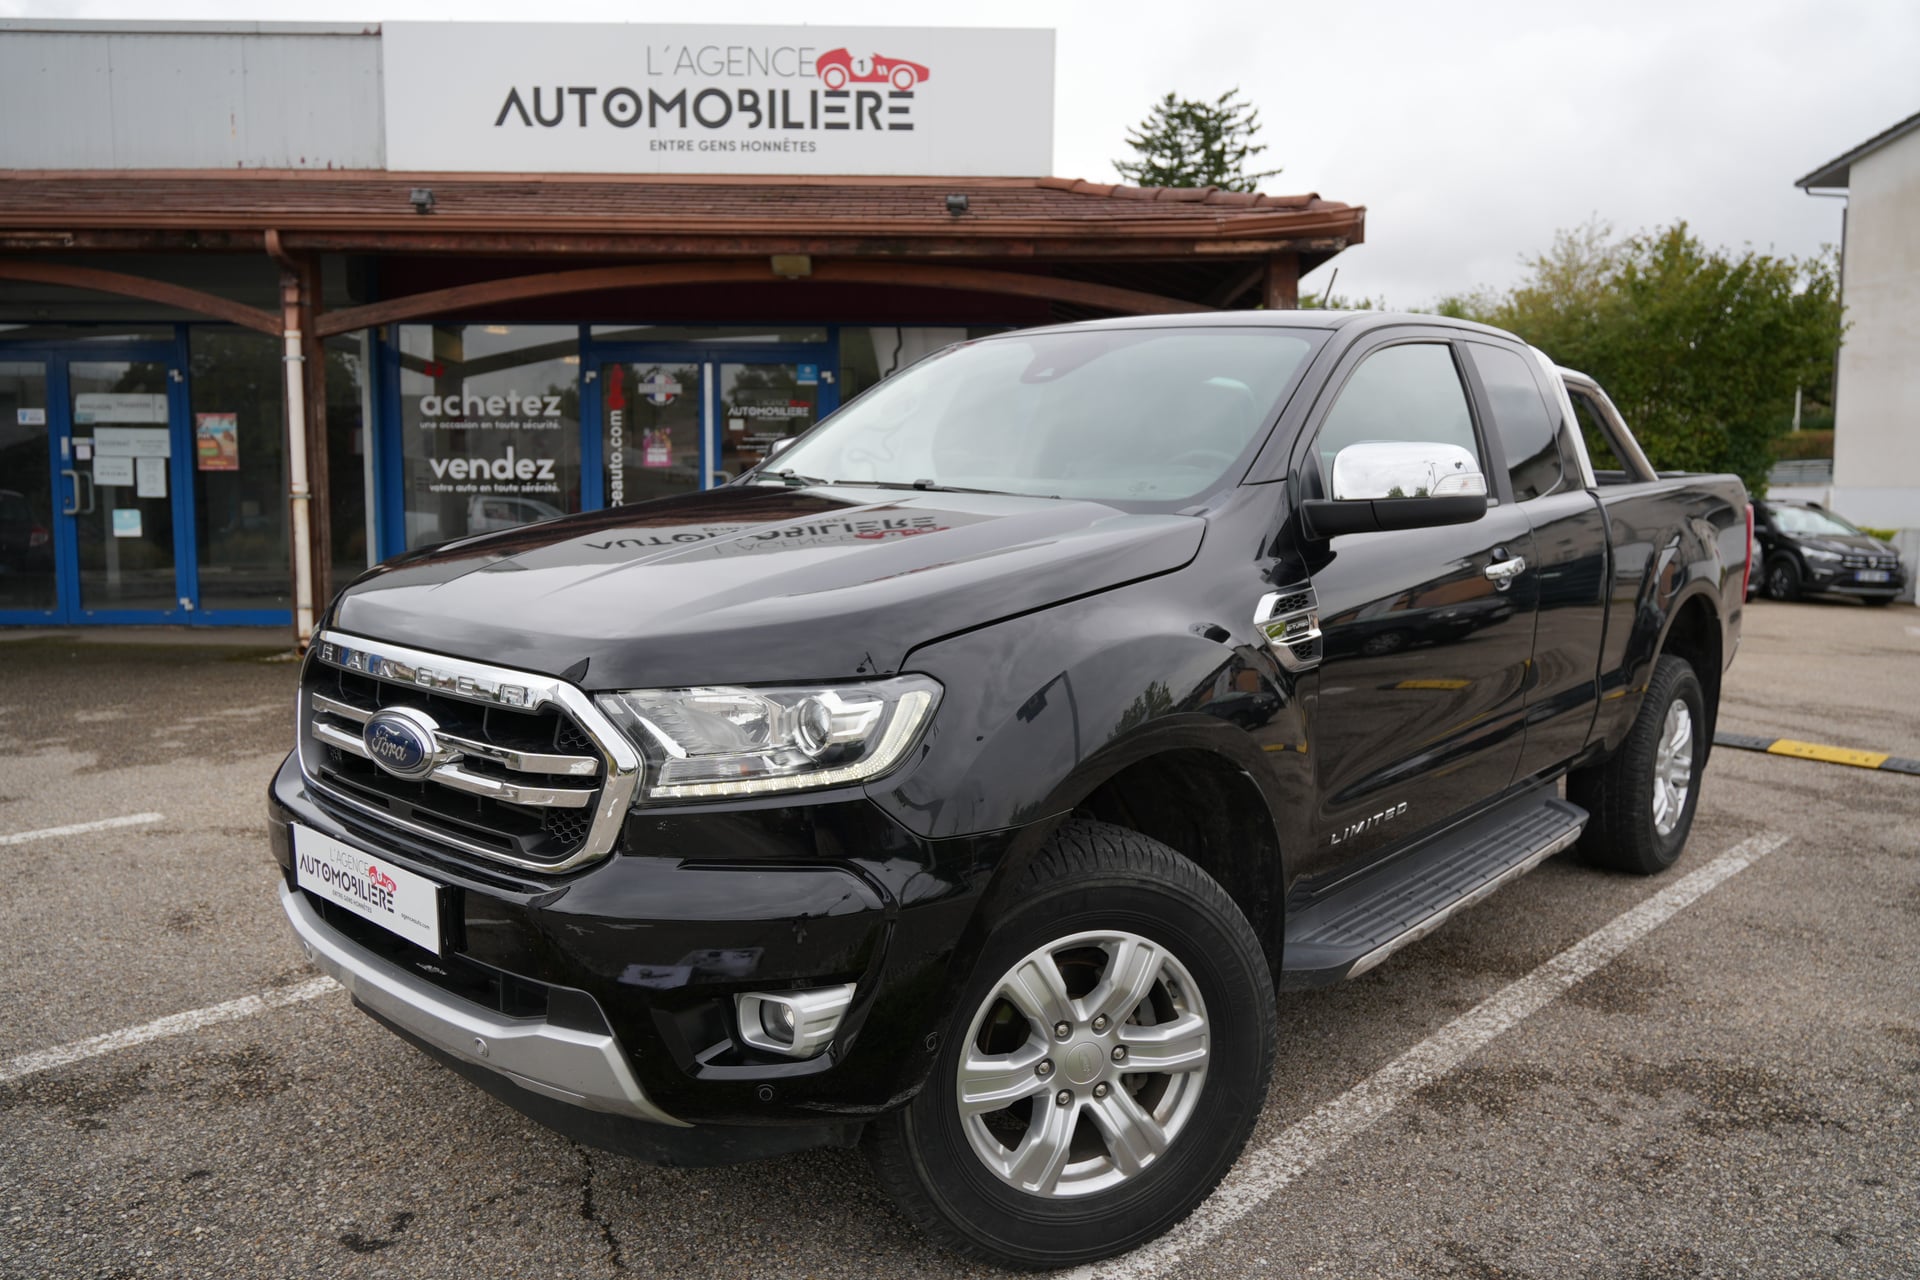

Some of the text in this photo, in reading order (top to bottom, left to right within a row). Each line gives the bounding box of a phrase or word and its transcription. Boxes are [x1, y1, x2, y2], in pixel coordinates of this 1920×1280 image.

[647, 44, 816, 78] L'AGENCE
[494, 86, 915, 131] AUTOMOBILIERE
[649, 137, 817, 153] ENTRE GENS HONNÊTES
[419, 383, 562, 417] achetez
[419, 421, 437, 430] une
[439, 419, 479, 430] occasion
[481, 421, 493, 430] en
[495, 420, 520, 430] toute
[429, 446, 555, 480] vendez
[429, 483, 454, 493] votre
[455, 483, 478, 493] auto
[480, 484, 492, 493] en
[494, 482, 519, 493] toute
[322, 643, 526, 707] RANGER
[371, 723, 407, 761] Ford
[1330, 801, 1408, 846] LIMITED
[300, 853, 395, 914] AUTOMOBILIERE
